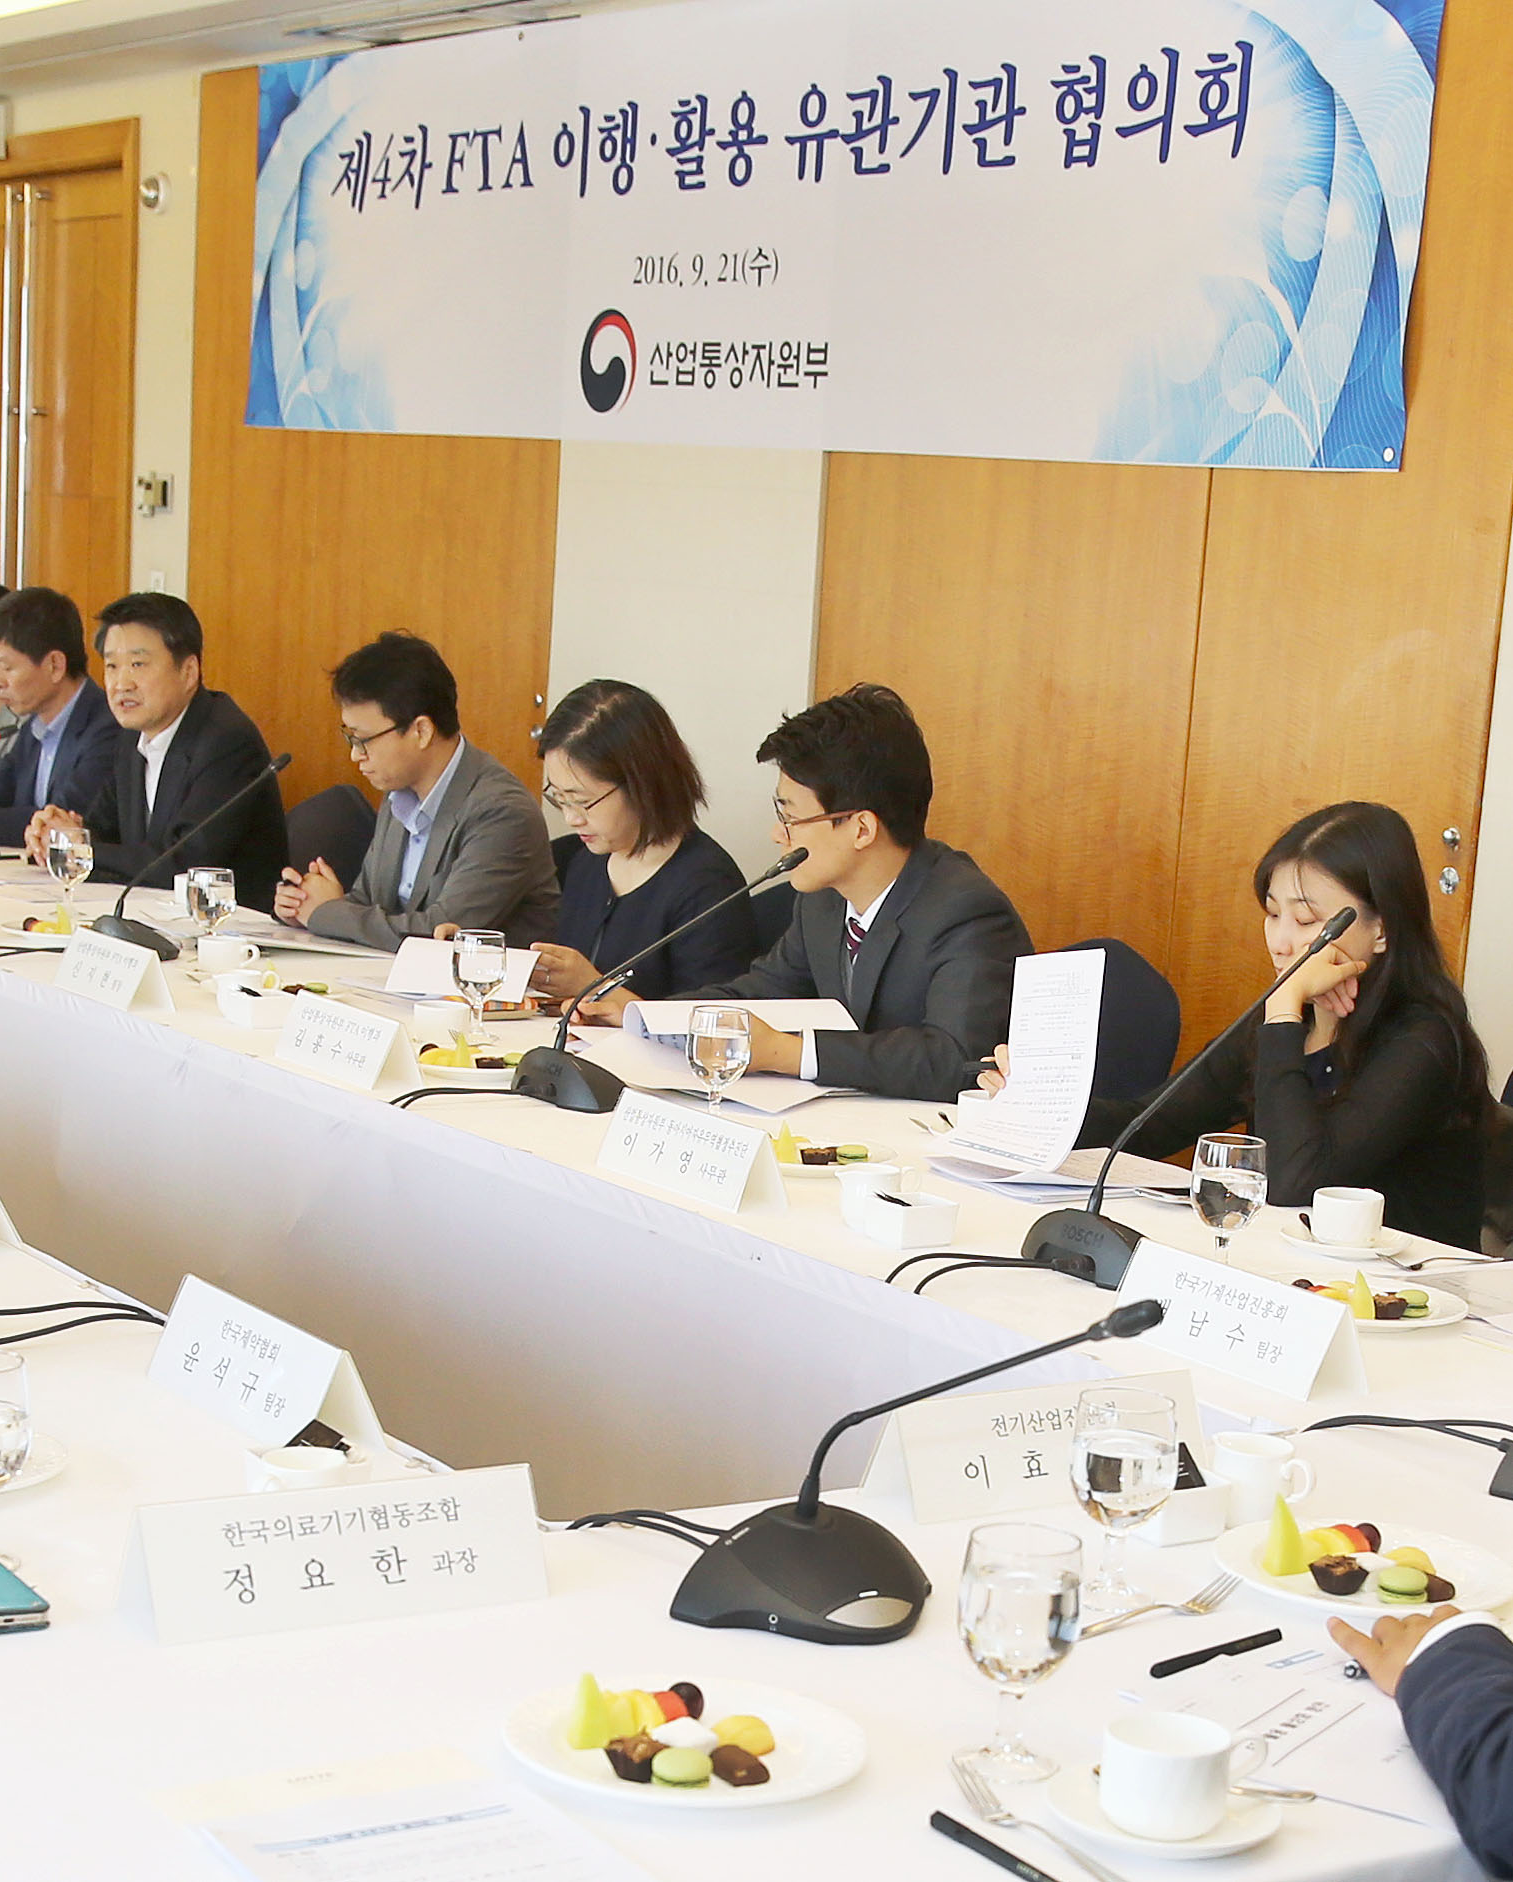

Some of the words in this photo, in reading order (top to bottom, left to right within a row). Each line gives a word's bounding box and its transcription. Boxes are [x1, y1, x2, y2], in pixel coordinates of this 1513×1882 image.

[330, 123, 432, 213] 제4차
[441, 120, 534, 194] FTA
[784, 62, 1027, 184] 유관기관
[1050, 40, 1255, 169] 협의회
[633, 252, 684, 287] 2016.
[692, 253, 709, 287] 9.
[717, 246, 779, 287] 21(수)
[649, 341, 829, 389] 산업통상자원부
[1175, 1271, 1290, 1323] 한국기계산업진흥회
[220, 1318, 282, 1366] 한국제약협회
[1256, 1340, 1284, 1365] 팀장
[265, 1391, 287, 1419] 팀장
[221, 1496, 462, 1549] 한국의료기기협동조합
[432, 1547, 479, 1576] 과장
